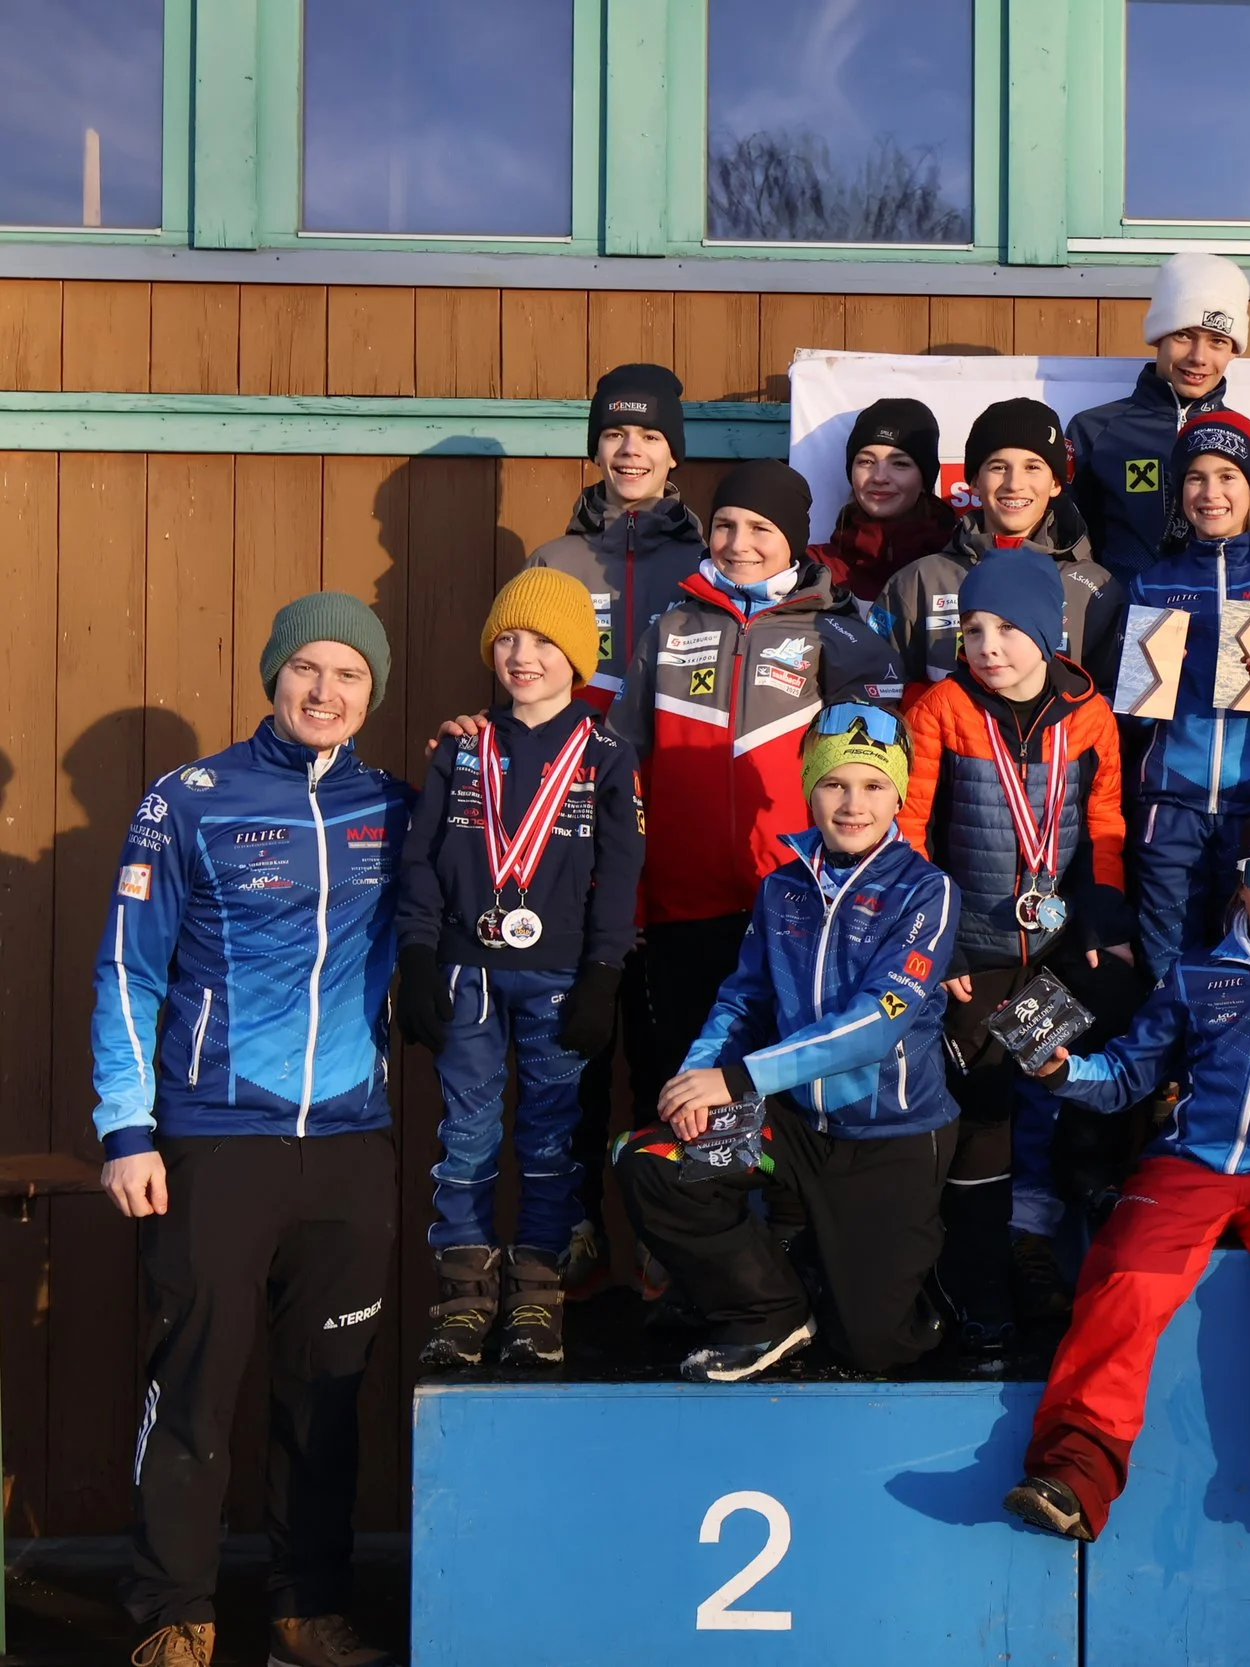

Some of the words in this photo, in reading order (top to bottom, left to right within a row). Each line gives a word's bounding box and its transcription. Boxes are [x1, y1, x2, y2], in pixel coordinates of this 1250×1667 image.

[608, 400, 648, 411] EISENERZ
[1167, 594, 1199, 604] FILTEC
[682, 636, 713, 646] SALZBURG
[687, 655, 716, 664] SKIPOOL
[786, 686, 799, 695] 2025
[843, 748, 889, 763] FISCHER
[236, 828, 286, 844] FILTEC
[1208, 977, 1244, 990] FILTEC
[1018, 1003, 1055, 1036] SAALFELDEN
[1034, 1021, 1070, 1053] SAALFELDEN
[338, 1297, 382, 1327] TERREX
[695, 1489, 793, 1631] 2
